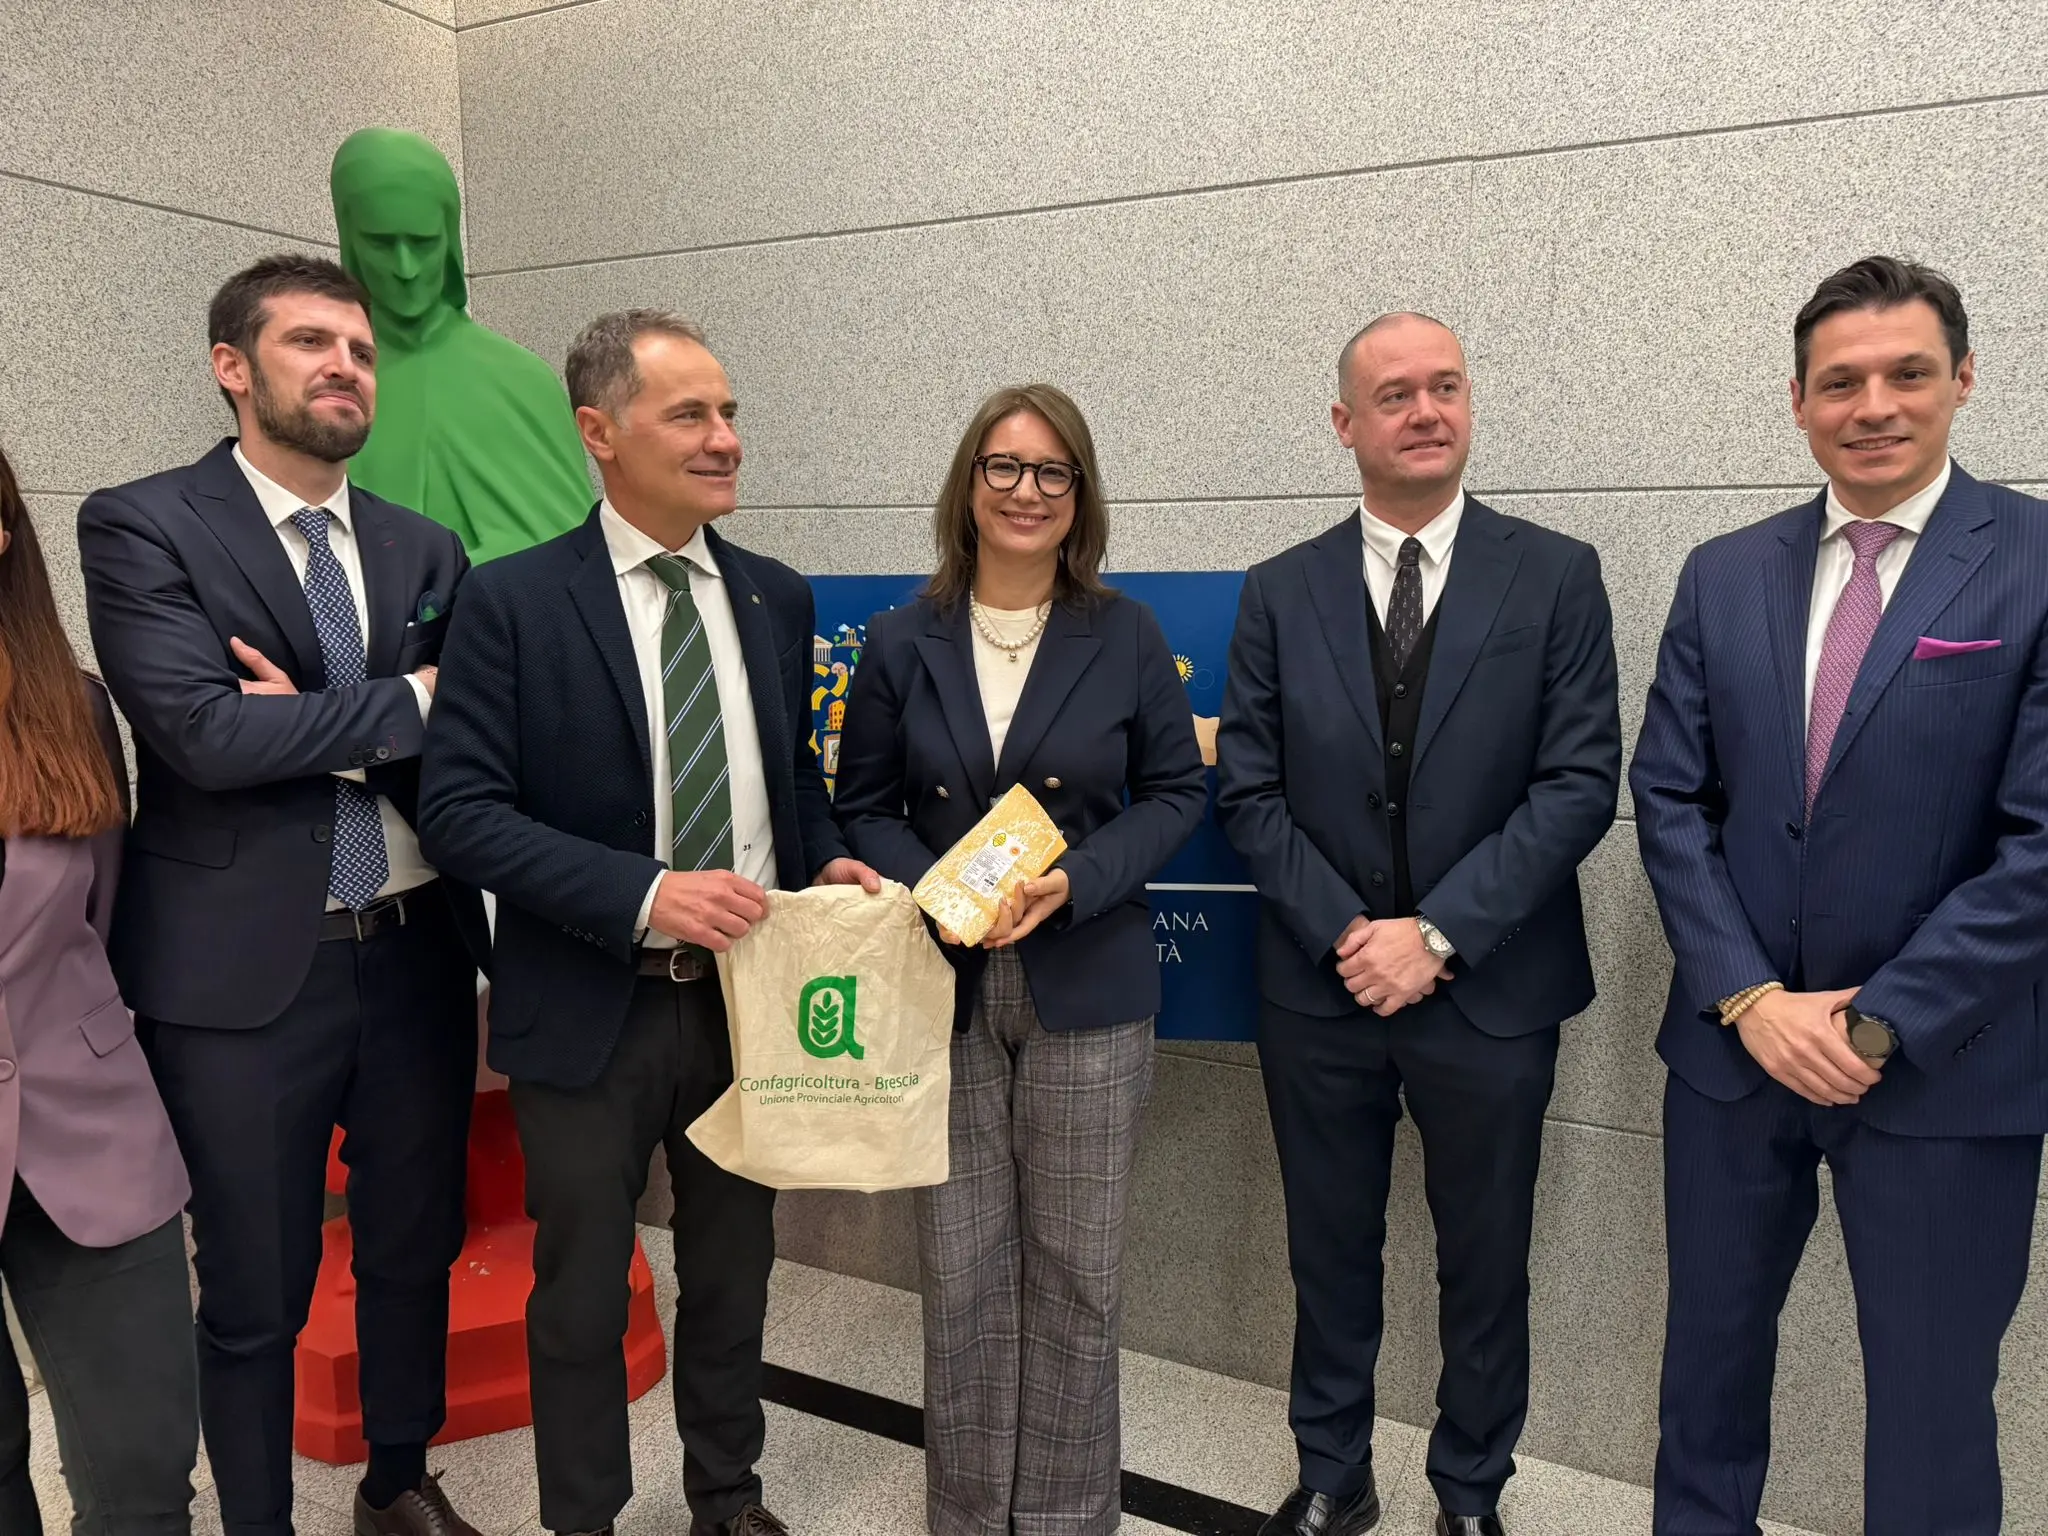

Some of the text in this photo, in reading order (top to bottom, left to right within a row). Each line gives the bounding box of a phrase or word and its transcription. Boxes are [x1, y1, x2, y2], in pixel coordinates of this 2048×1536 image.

[1152, 911, 1209, 931] ANA
[739, 1073, 860, 1092] Confagricoltura
[874, 1072, 919, 1090] Brescia
[759, 1095, 795, 1105] Unione
[796, 1092, 852, 1104] Provinciale
